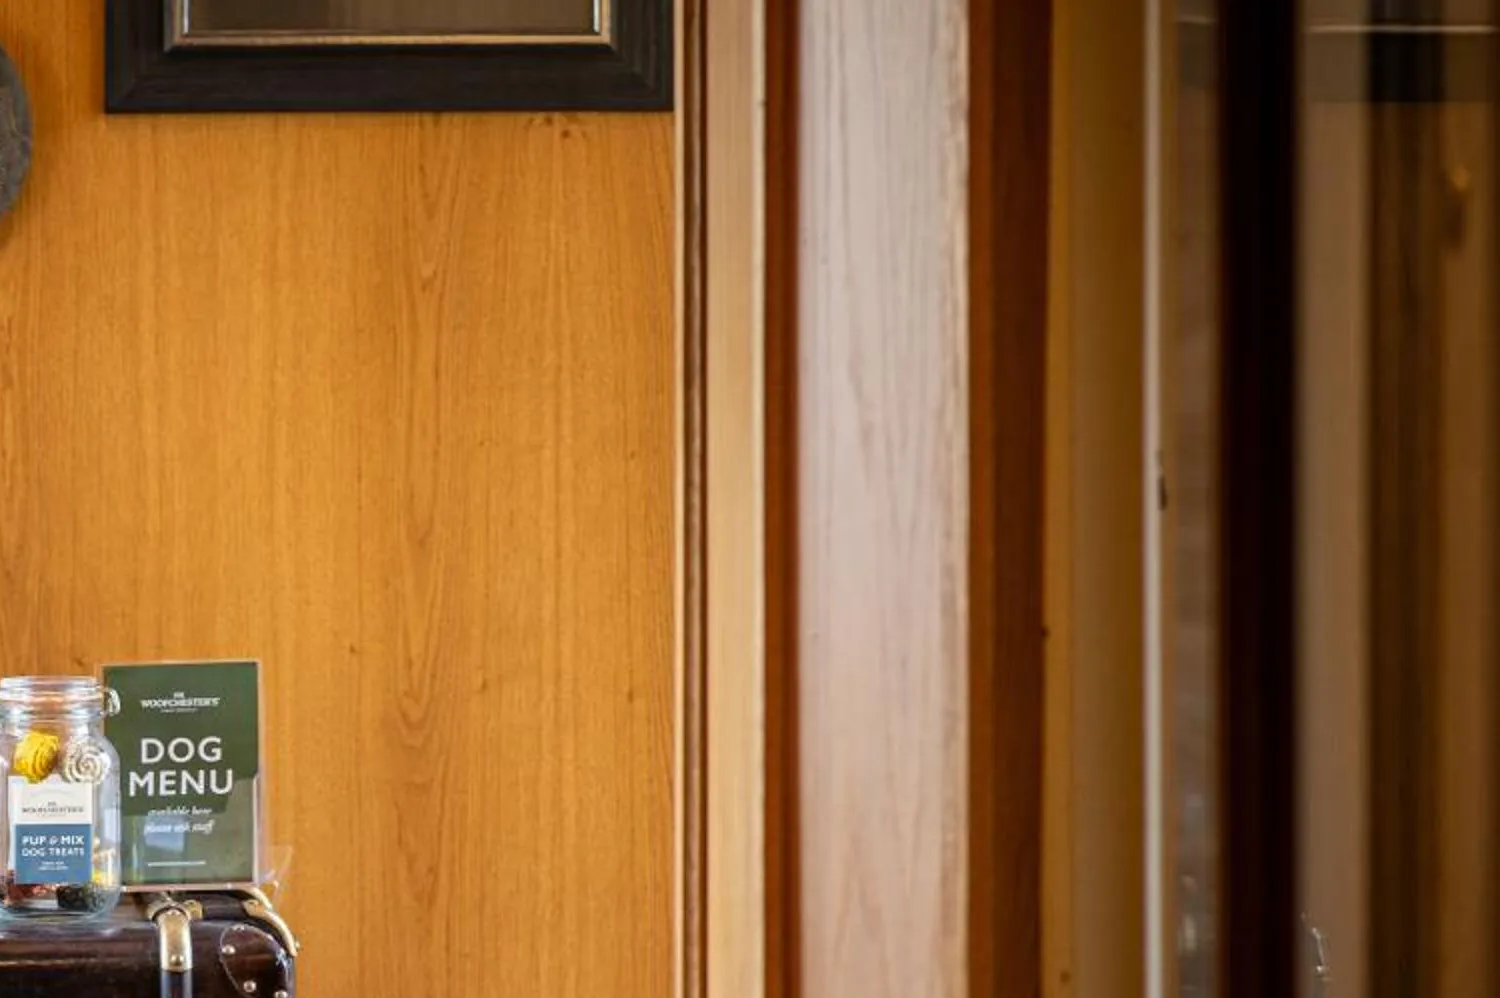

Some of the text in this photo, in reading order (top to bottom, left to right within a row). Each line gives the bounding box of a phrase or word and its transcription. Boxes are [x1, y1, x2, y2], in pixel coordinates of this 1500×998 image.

[140, 736, 223, 764] DOG
[128, 768, 234, 797] MENU
[21, 834, 47, 845] PUP
[60, 834, 84, 845] MIX
[21, 847, 84, 857] DOG TREATS
